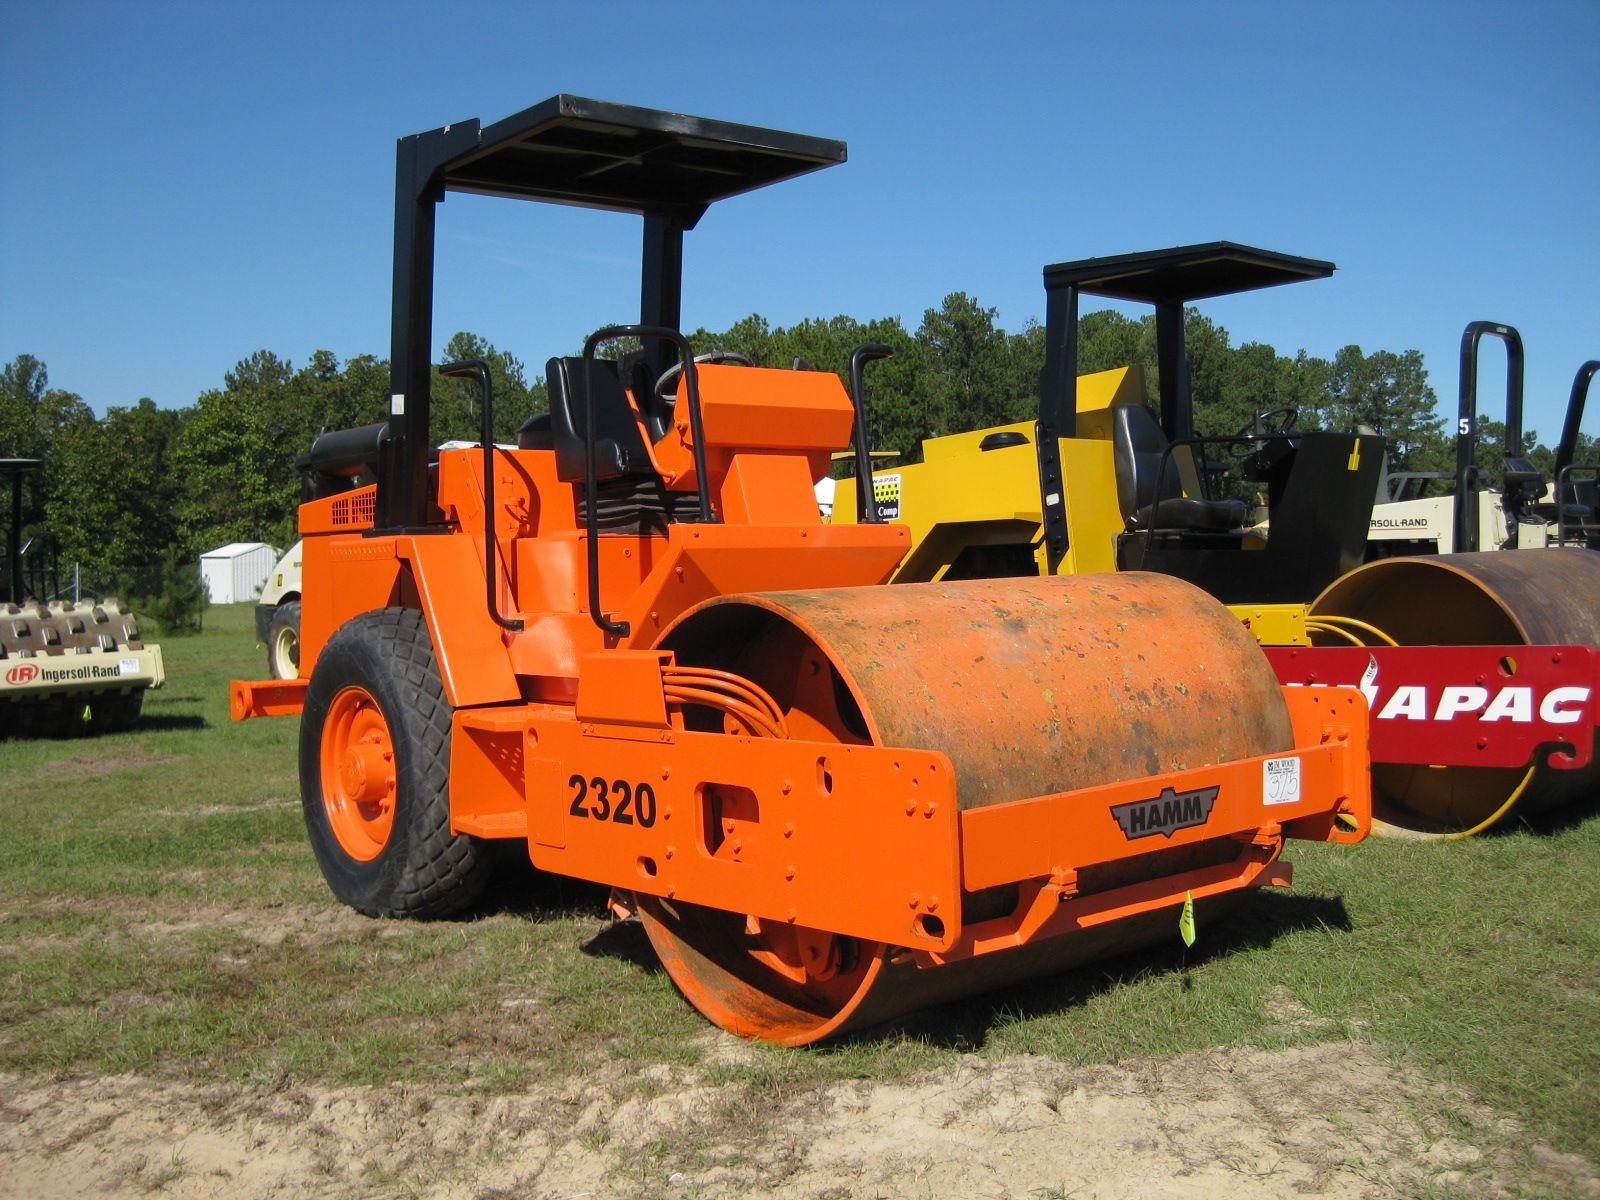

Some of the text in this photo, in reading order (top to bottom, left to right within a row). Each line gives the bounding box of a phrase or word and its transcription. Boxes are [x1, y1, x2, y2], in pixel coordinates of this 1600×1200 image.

[1460, 419, 1469, 434] 5
[878, 507, 897, 517] Comp
[11, 667, 34, 681] IR
[1269, 772, 1298, 799] 375
[568, 774, 656, 828] 2320
[1130, 796, 1202, 833] HAMM
